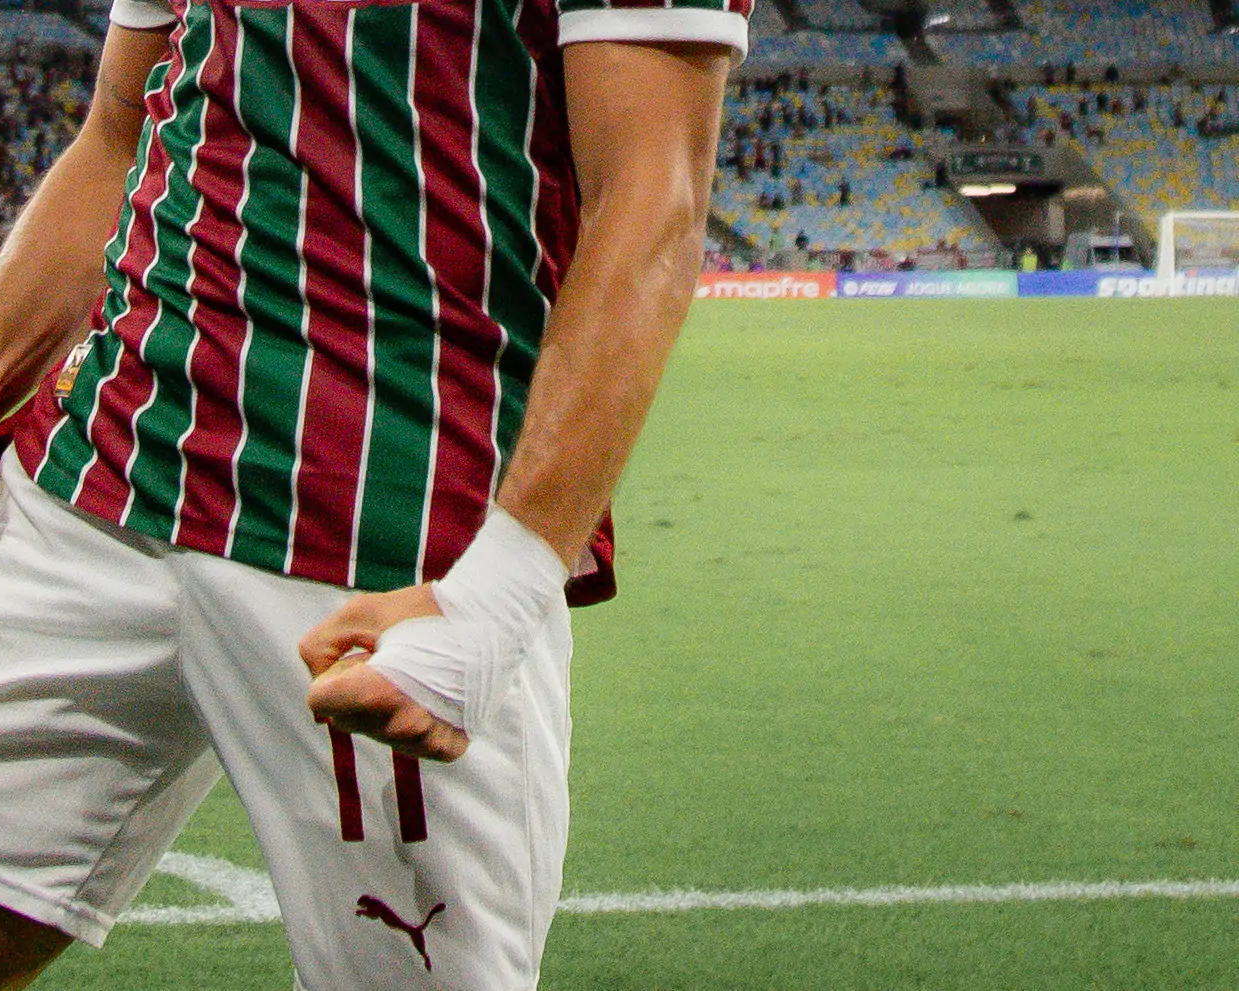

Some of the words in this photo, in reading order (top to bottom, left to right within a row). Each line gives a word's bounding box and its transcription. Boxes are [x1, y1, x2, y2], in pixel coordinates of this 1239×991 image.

[713, 277, 820, 300] mapfre
[1099, 267, 1239, 298] spoting
[314, 715, 428, 843] 11
